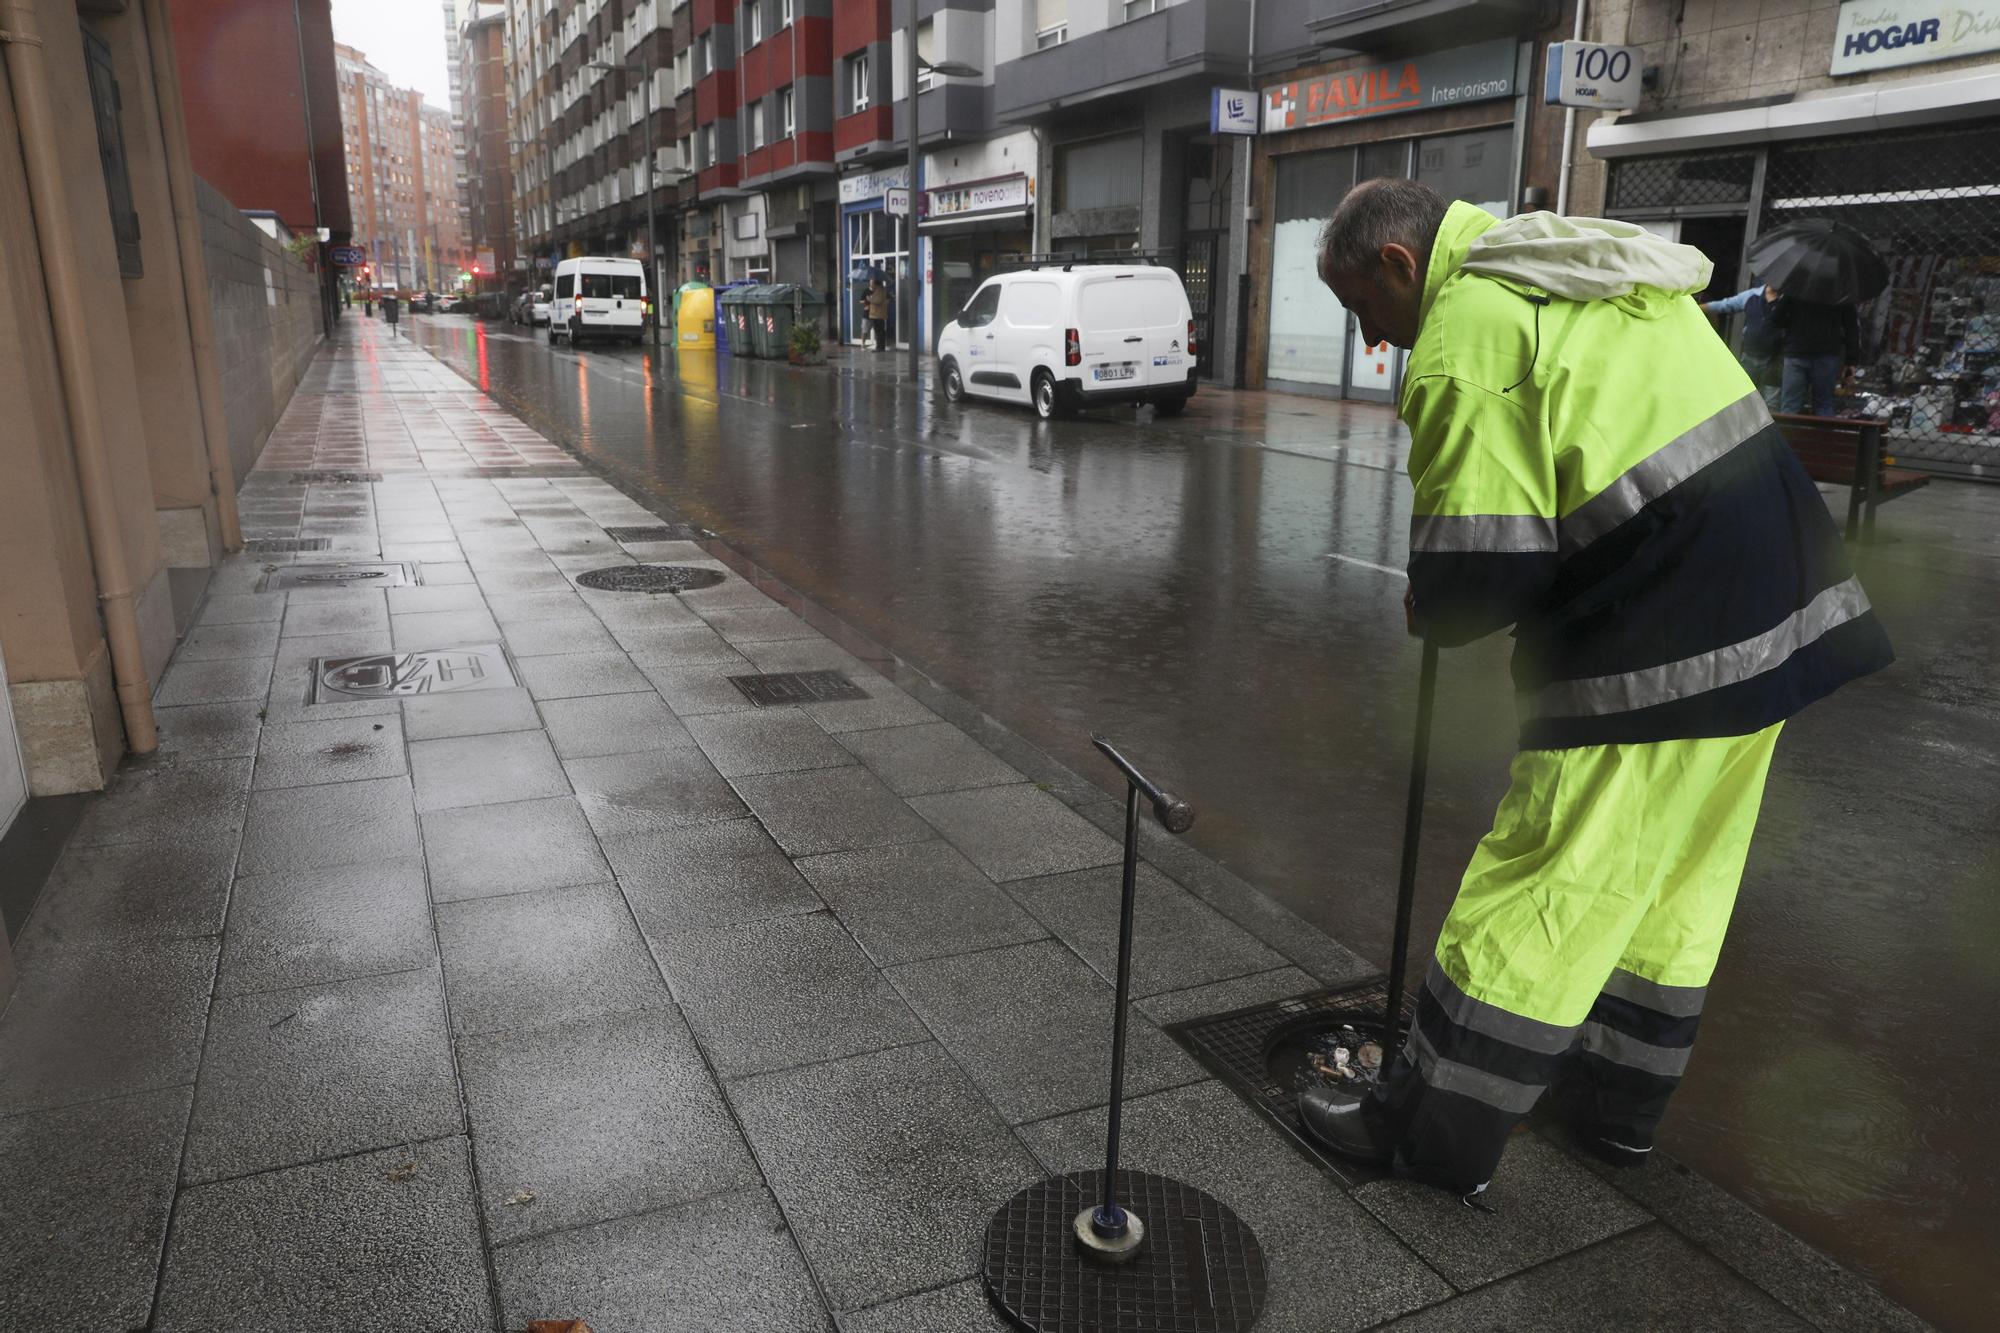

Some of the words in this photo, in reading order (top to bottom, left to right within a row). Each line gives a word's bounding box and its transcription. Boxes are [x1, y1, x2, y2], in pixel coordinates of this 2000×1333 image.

[1843, 18, 1940, 57] HOGAR
[1575, 48, 1631, 83] 100
[1306, 63, 1420, 113] FAVILA
[1432, 79, 1507, 103] Interiorismo
[1575, 88, 1598, 96] HOGAR
